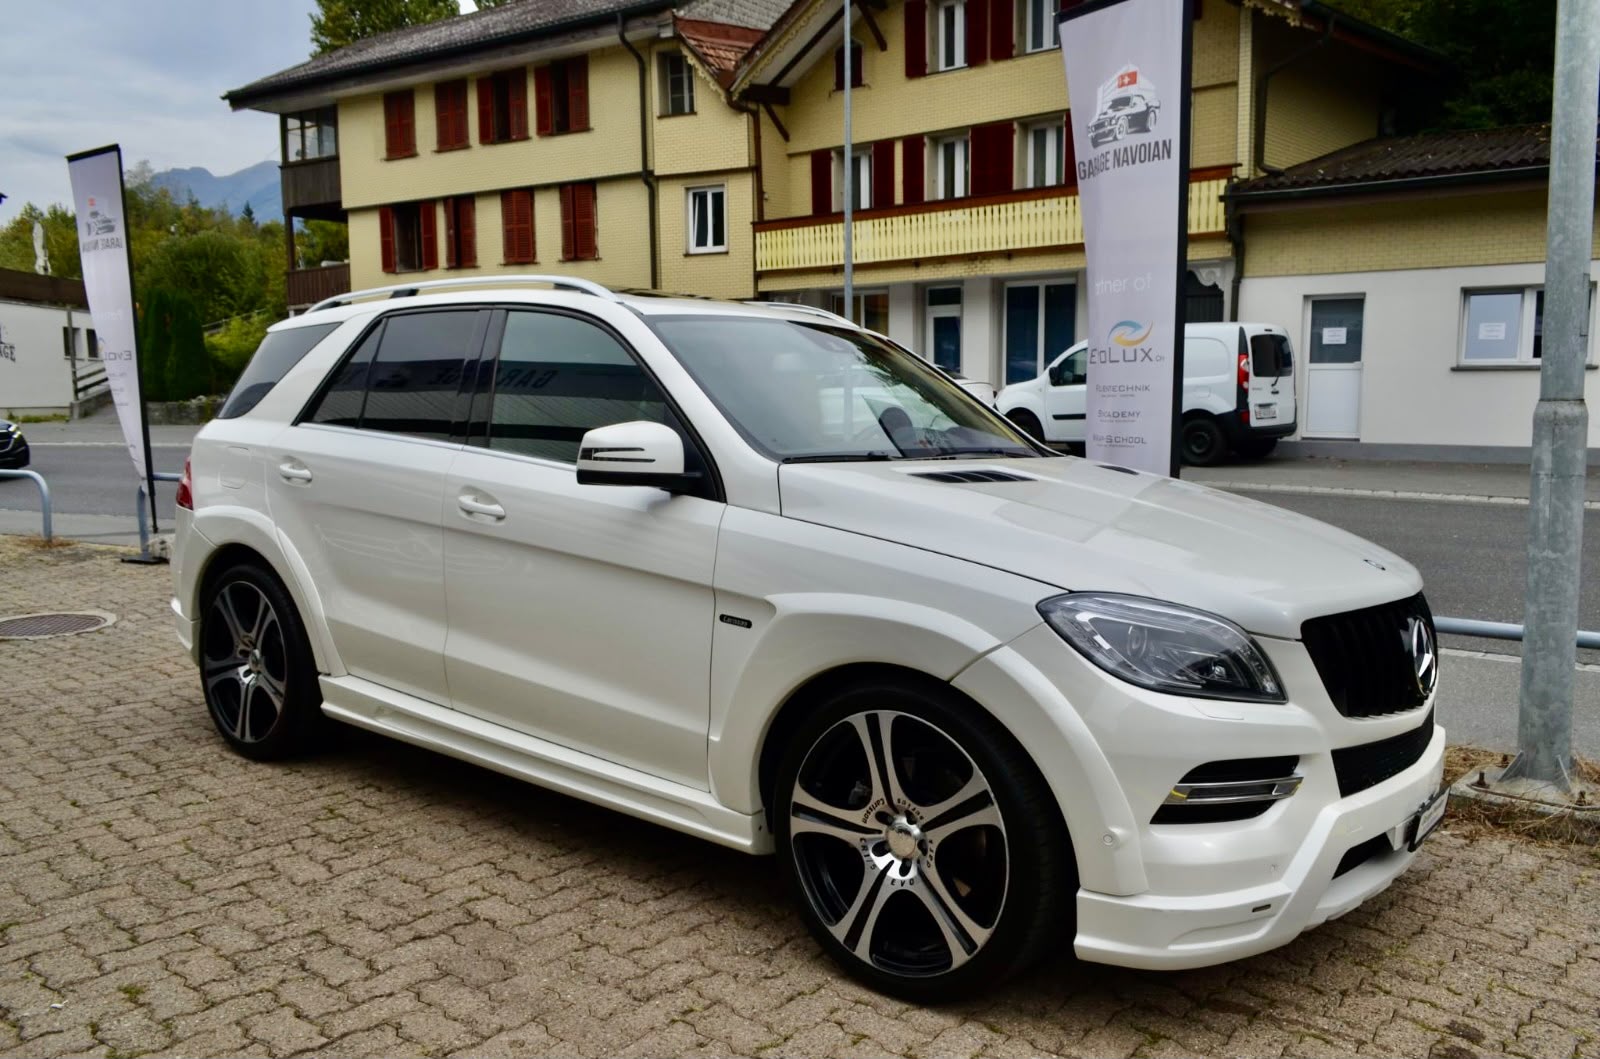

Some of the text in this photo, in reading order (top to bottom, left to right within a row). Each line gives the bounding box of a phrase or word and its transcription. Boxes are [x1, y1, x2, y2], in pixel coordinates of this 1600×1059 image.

[1113, 139, 1172, 169] NAVOIAN
[1134, 272, 1153, 291] of
[890, 878, 915, 887] EVO
